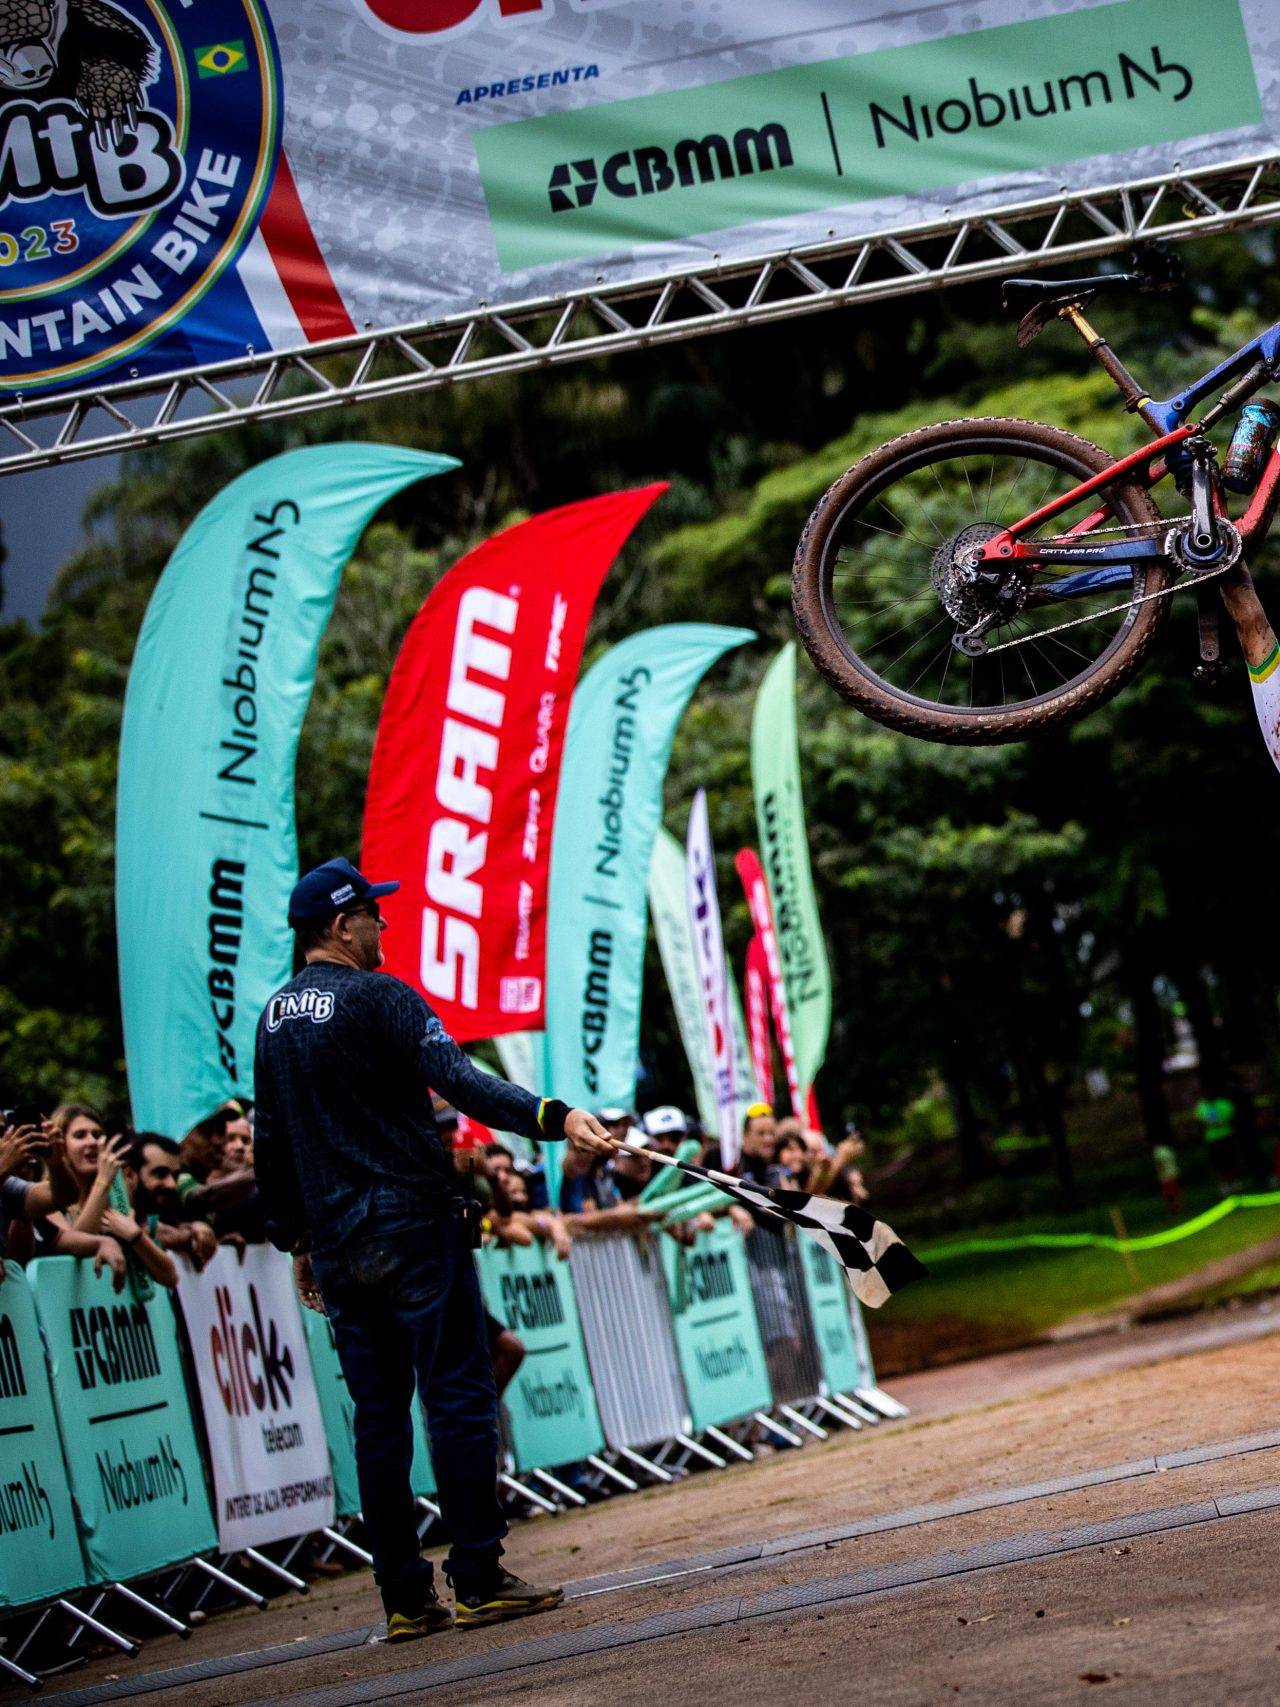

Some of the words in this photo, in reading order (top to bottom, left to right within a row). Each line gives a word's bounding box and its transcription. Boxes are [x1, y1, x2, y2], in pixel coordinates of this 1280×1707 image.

[455, 64, 600, 105] APRESENTA
[151, 148, 242, 275] BIKE
[419, 584, 520, 1011] SRAM
[210, 1283, 296, 1417] click
